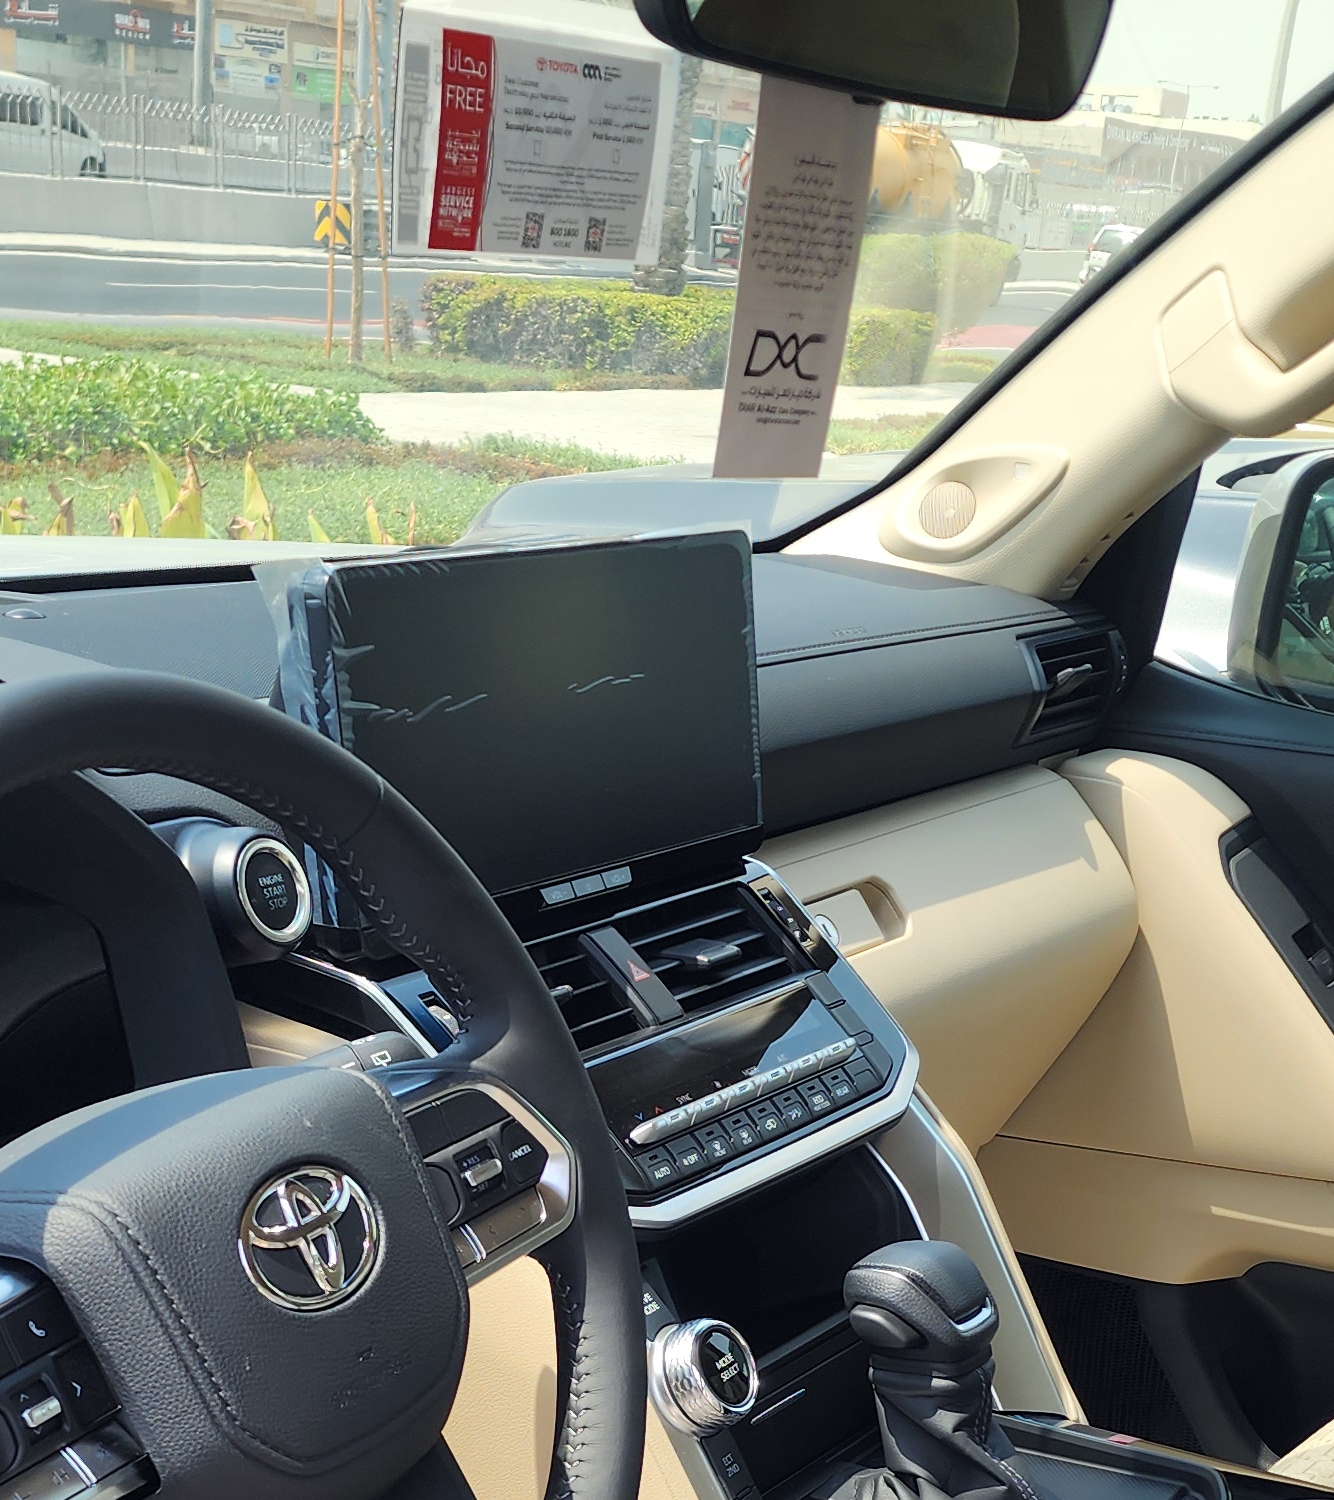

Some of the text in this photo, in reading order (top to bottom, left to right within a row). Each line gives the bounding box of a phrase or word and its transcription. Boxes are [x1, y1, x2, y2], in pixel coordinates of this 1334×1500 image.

[548, 60, 579, 75] TOYOTA
[445, 84, 486, 113] FREE
[440, 194, 475, 209] SERVICE
[258, 873, 284, 887] ENGINE
[263, 884, 286, 899] START
[268, 896, 288, 910] STOP
[508, 1144, 533, 1161] CANCEL
[686, 1153, 700, 1165] OFF
[653, 1166, 671, 1180] AUTO
[714, 1352, 735, 1370] MODE
[720, 1363, 740, 1383] SELECT
[722, 1452, 733, 1467] ECT
